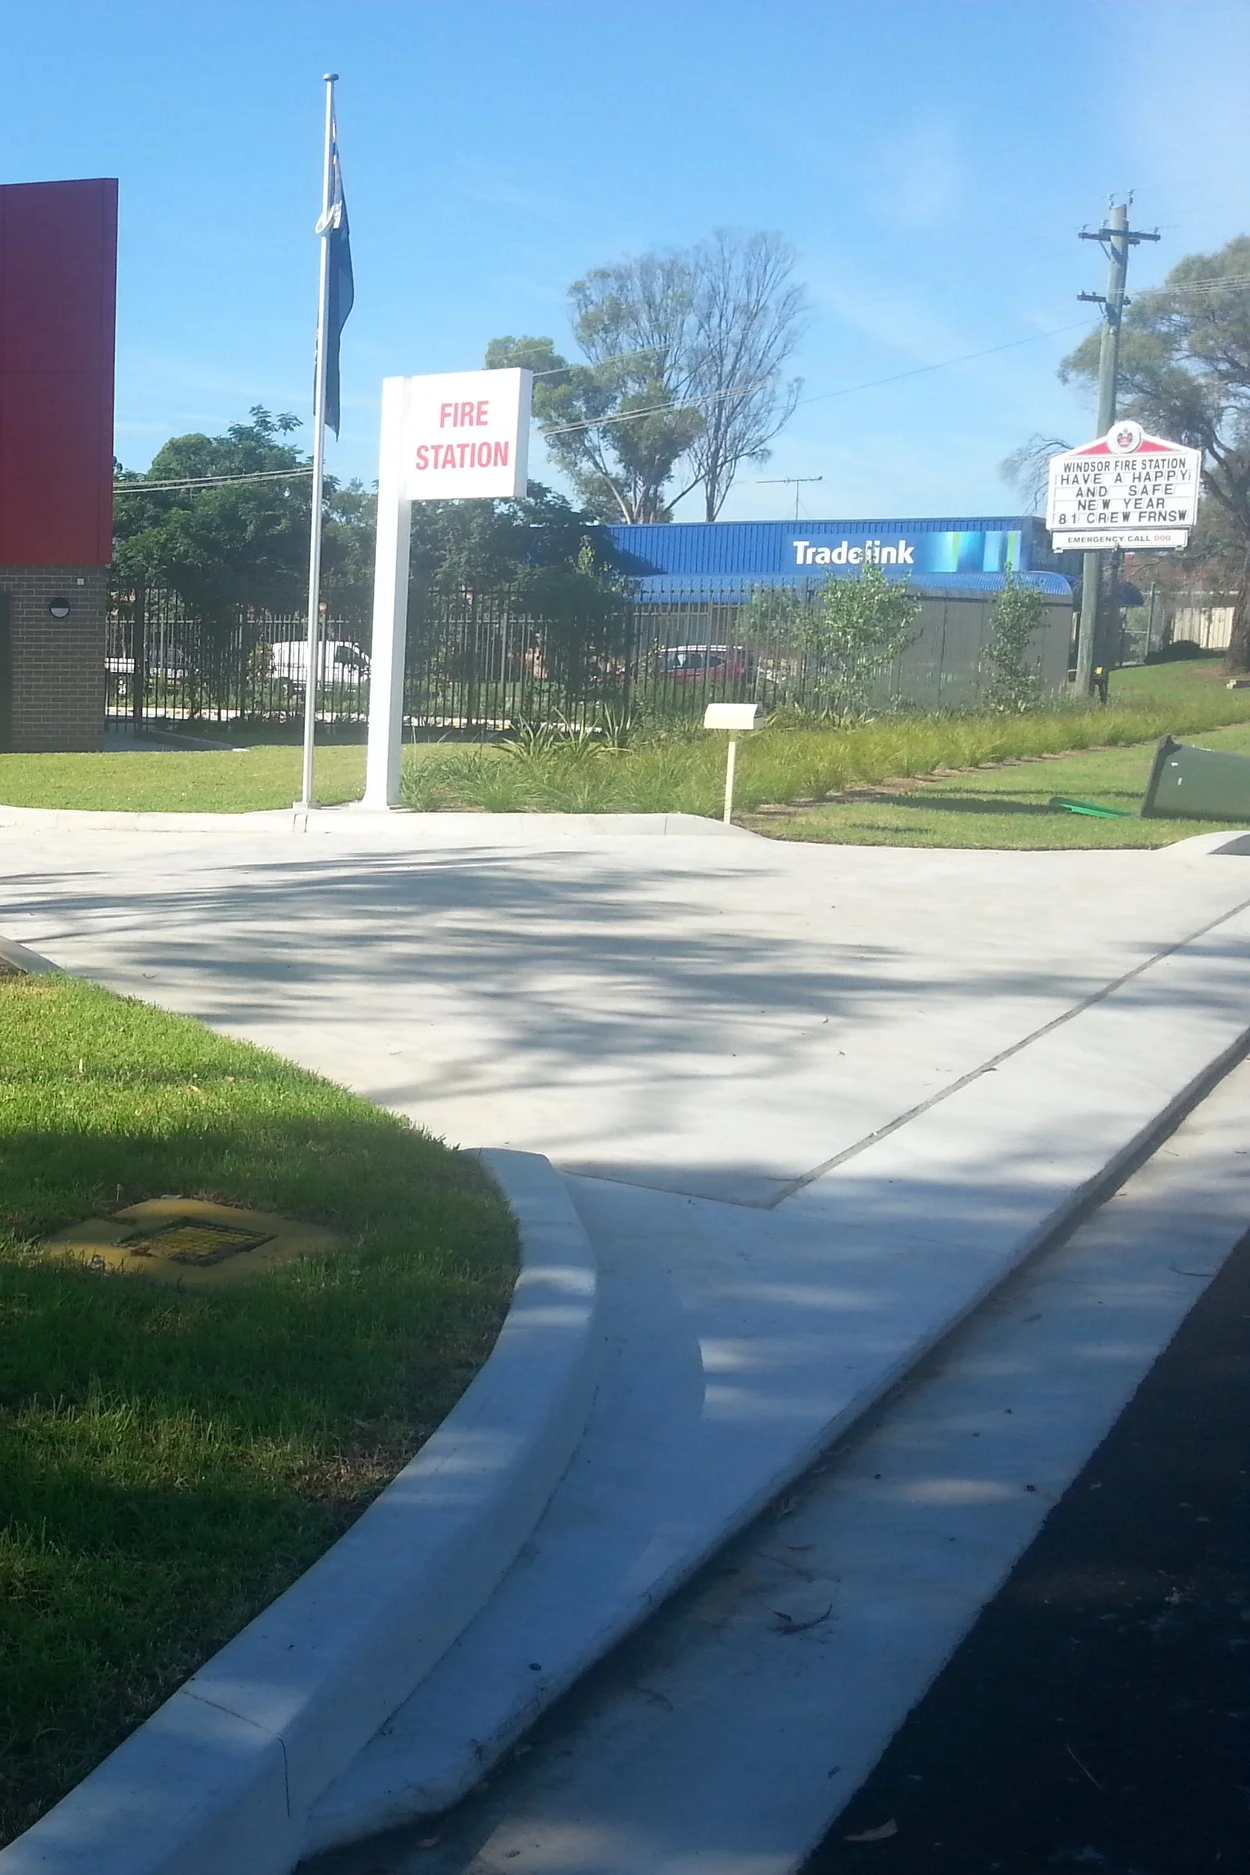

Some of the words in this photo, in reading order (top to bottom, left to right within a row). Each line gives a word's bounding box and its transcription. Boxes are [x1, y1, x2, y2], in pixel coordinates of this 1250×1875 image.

[440, 400, 489, 428] FIRE
[415, 441, 509, 471] STATION
[1064, 460, 1111, 473] WINDSOR
[1114, 460, 1137, 471] FIRE
[1141, 457, 1186, 470] STATION
[1060, 473, 1102, 485] HAVE
[1114, 472, 1123, 483] A
[1132, 469, 1188, 483] HAPPY
[1076, 486, 1108, 498] AND
[1128, 483, 1173, 496] SAFE
[1077, 499, 1111, 511] NEW
[1123, 498, 1165, 509] YEAR
[1058, 513, 1077, 525] 81
[1087, 512, 1131, 523] CREW
[1138, 510, 1187, 523] FRNSW
[1068, 535, 1124, 543] EMERGENCY
[793, 540, 915, 565] Tradelink
